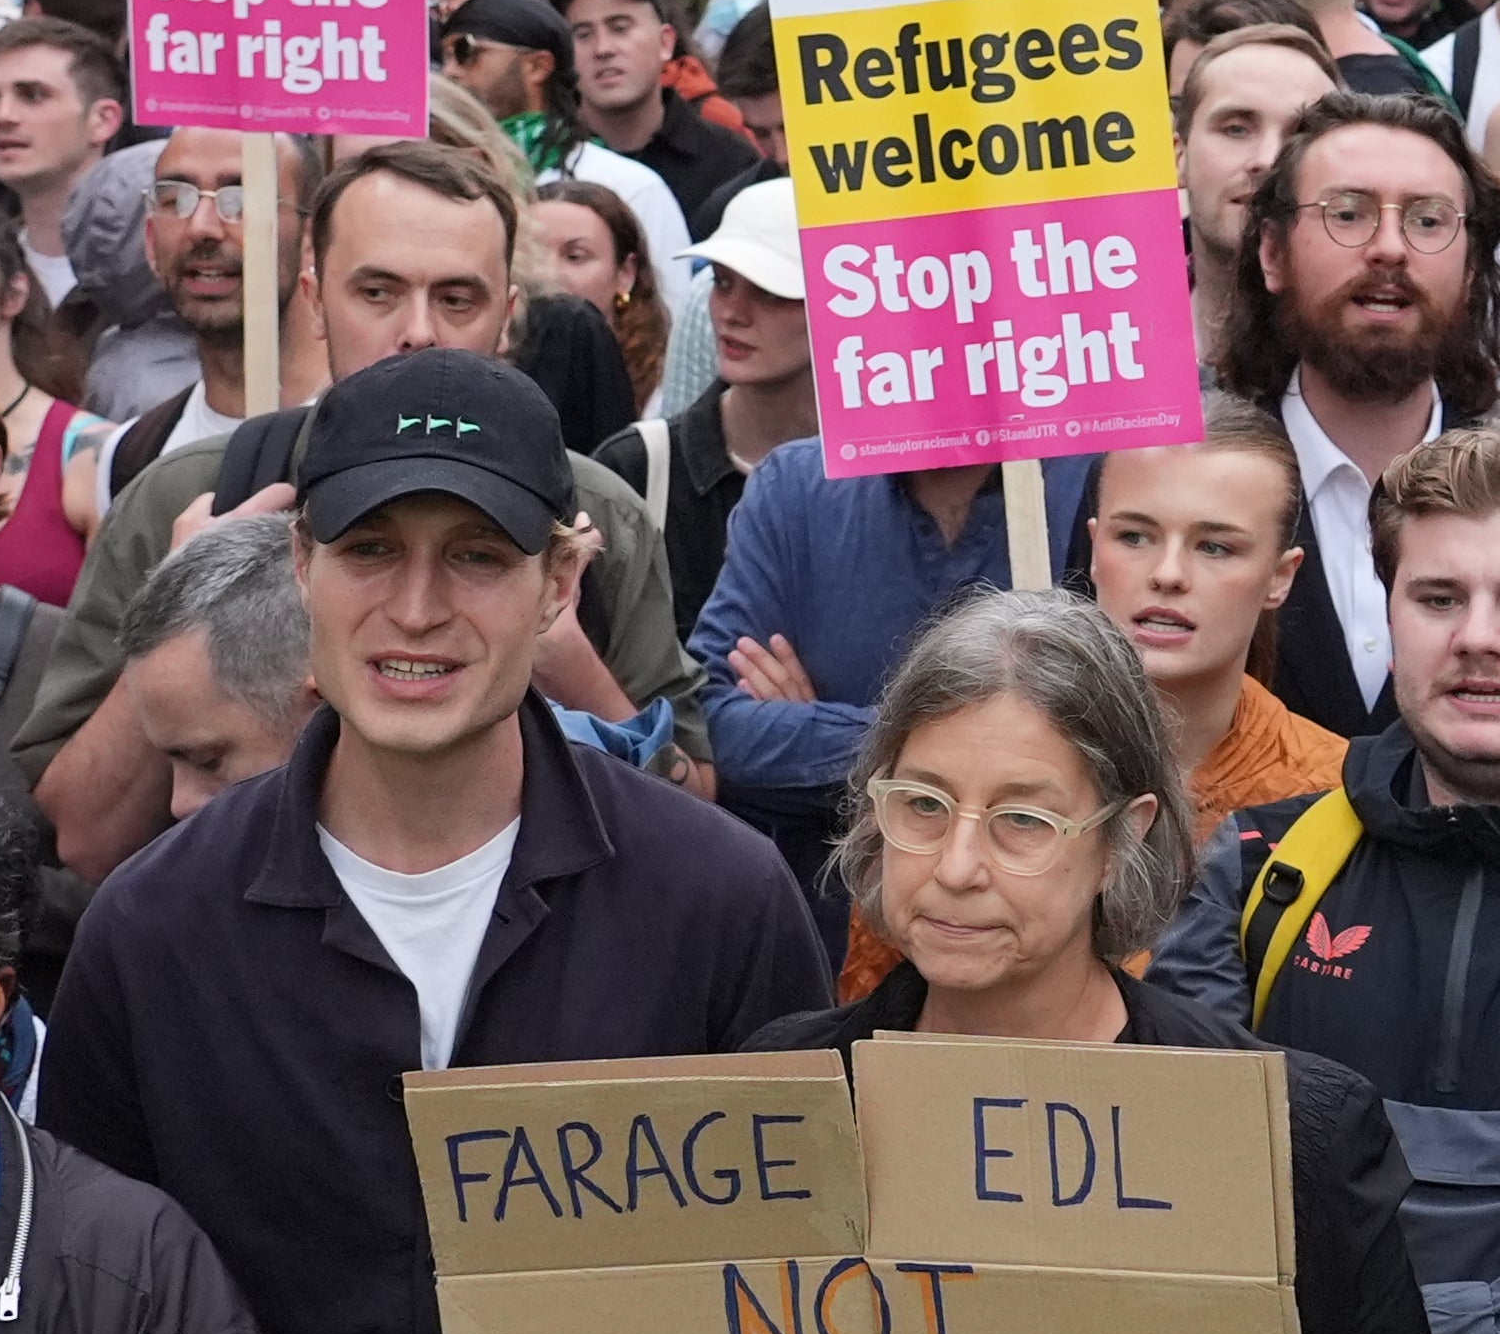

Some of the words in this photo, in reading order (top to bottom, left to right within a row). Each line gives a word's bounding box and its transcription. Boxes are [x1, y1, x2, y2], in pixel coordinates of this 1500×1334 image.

[796, 17, 1144, 105] Refugees
[809, 109, 1136, 195] welcome
[822, 242, 992, 325] Stop
[1010, 221, 1138, 298] the
[834, 335, 944, 409] far
[964, 311, 1144, 409] right
[860, 435, 971, 457] standuptoracismuk
[444, 1109, 812, 1223] FARAGE
[971, 1096, 1174, 1212] EDL
